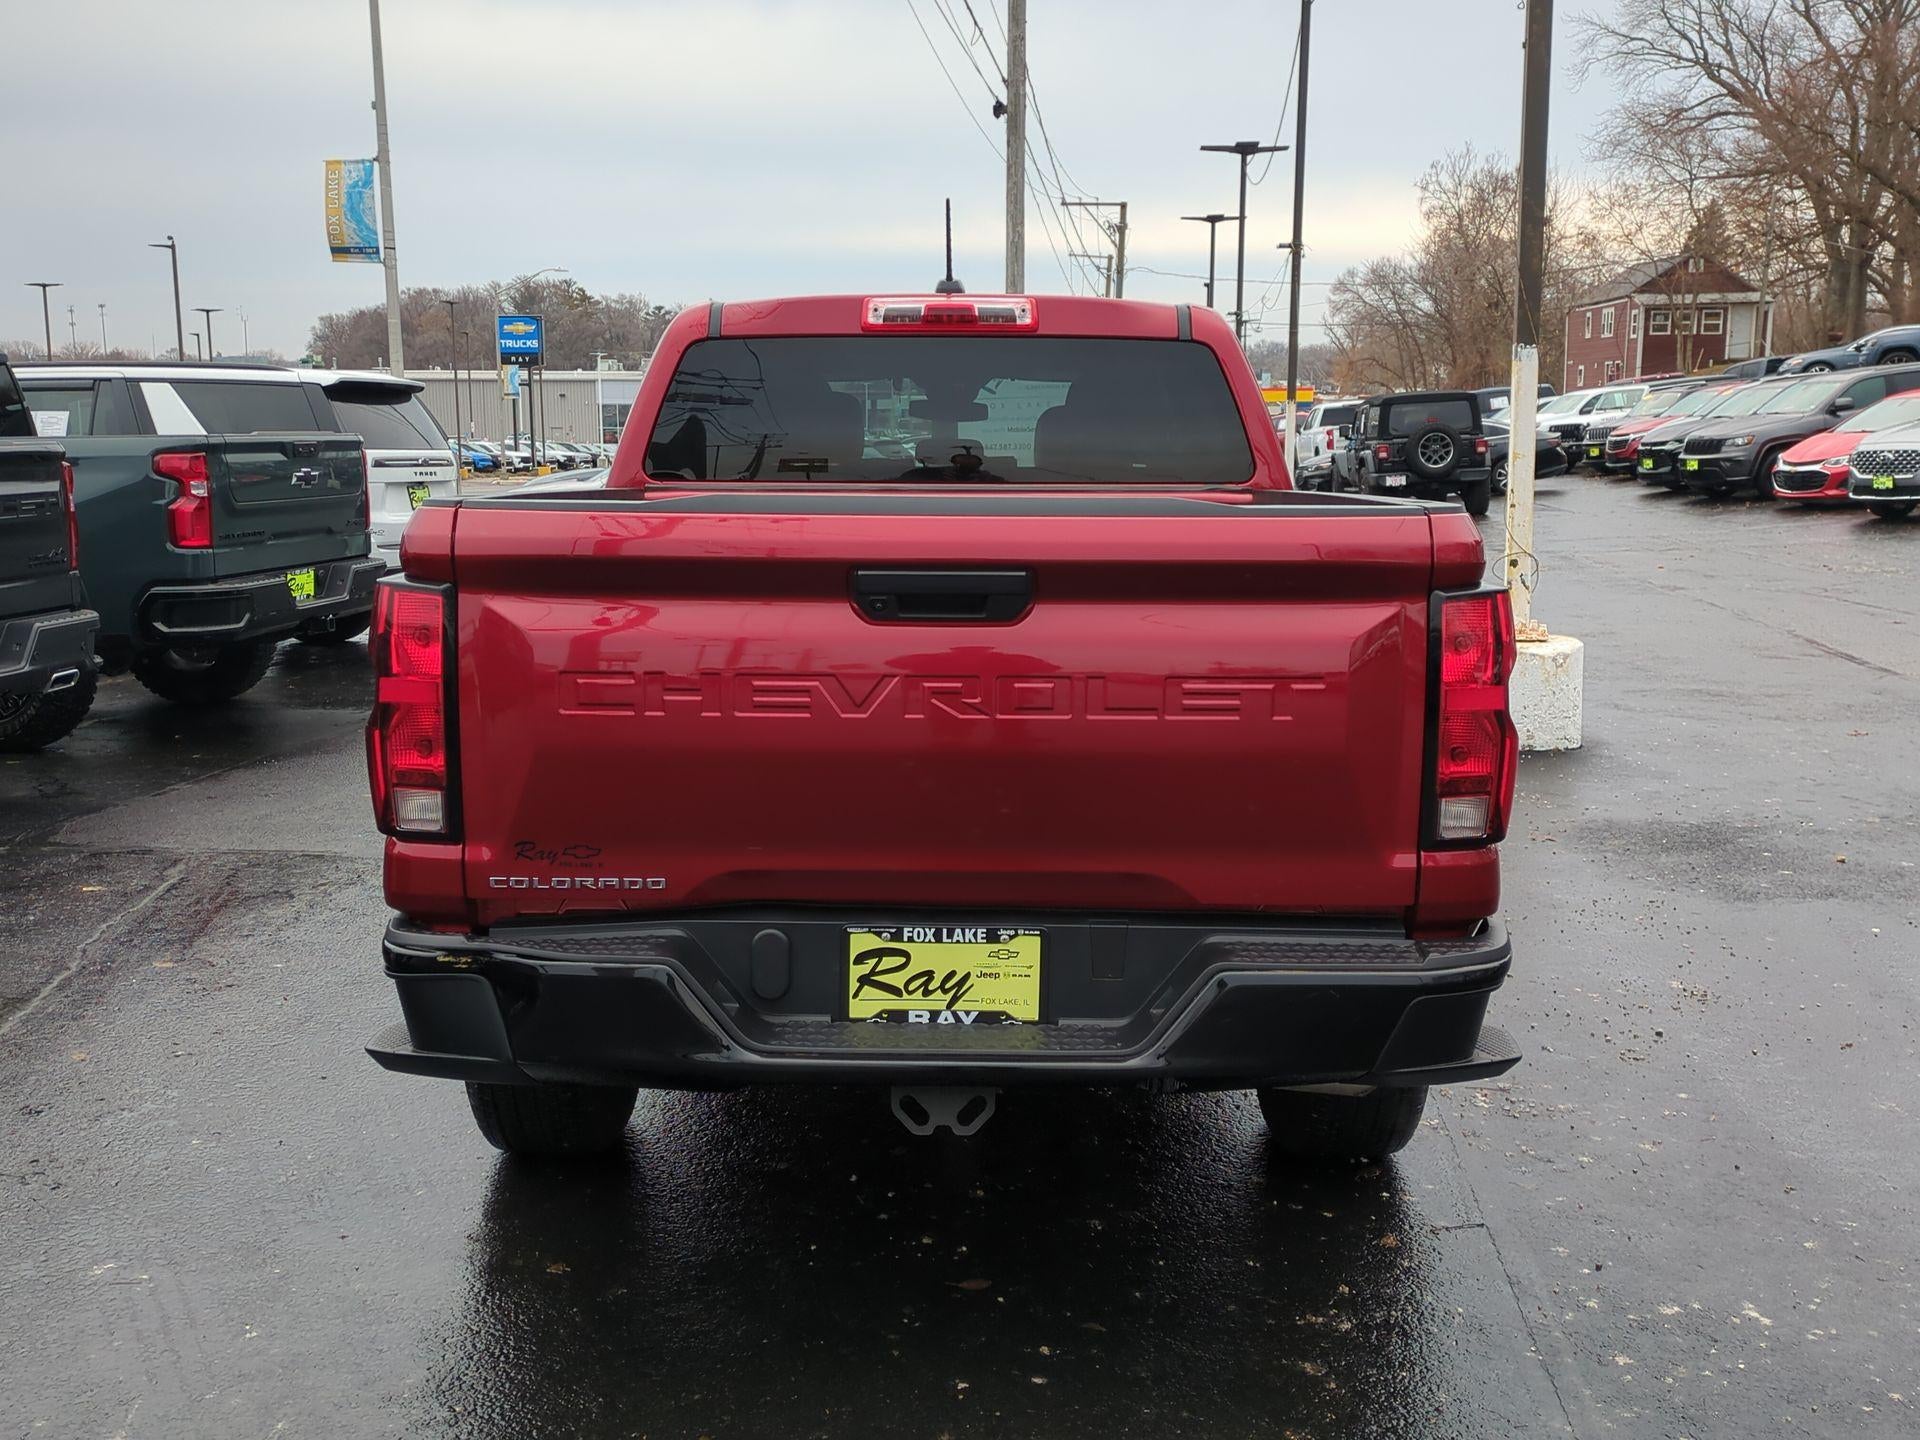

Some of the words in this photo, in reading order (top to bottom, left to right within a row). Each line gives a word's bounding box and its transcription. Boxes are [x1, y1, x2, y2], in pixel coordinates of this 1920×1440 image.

[328, 170, 339, 208] LAKE
[328, 215, 341, 244] FOX
[500, 339, 539, 348] TRUCKS
[558, 673, 1327, 720] CHEVROLET
[514, 840, 559, 864] Ray
[489, 876, 666, 889] COLORADO
[903, 927, 936, 942] FOX
[942, 928, 987, 943] LAKE
[997, 928, 1016, 936] Jeep
[852, 947, 974, 1010] Ray
[976, 970, 1001, 980] Jeep
[980, 997, 997, 1005] FOX
[1023, 998, 1030, 1006] IL
[908, 1010, 979, 1024] RAY
